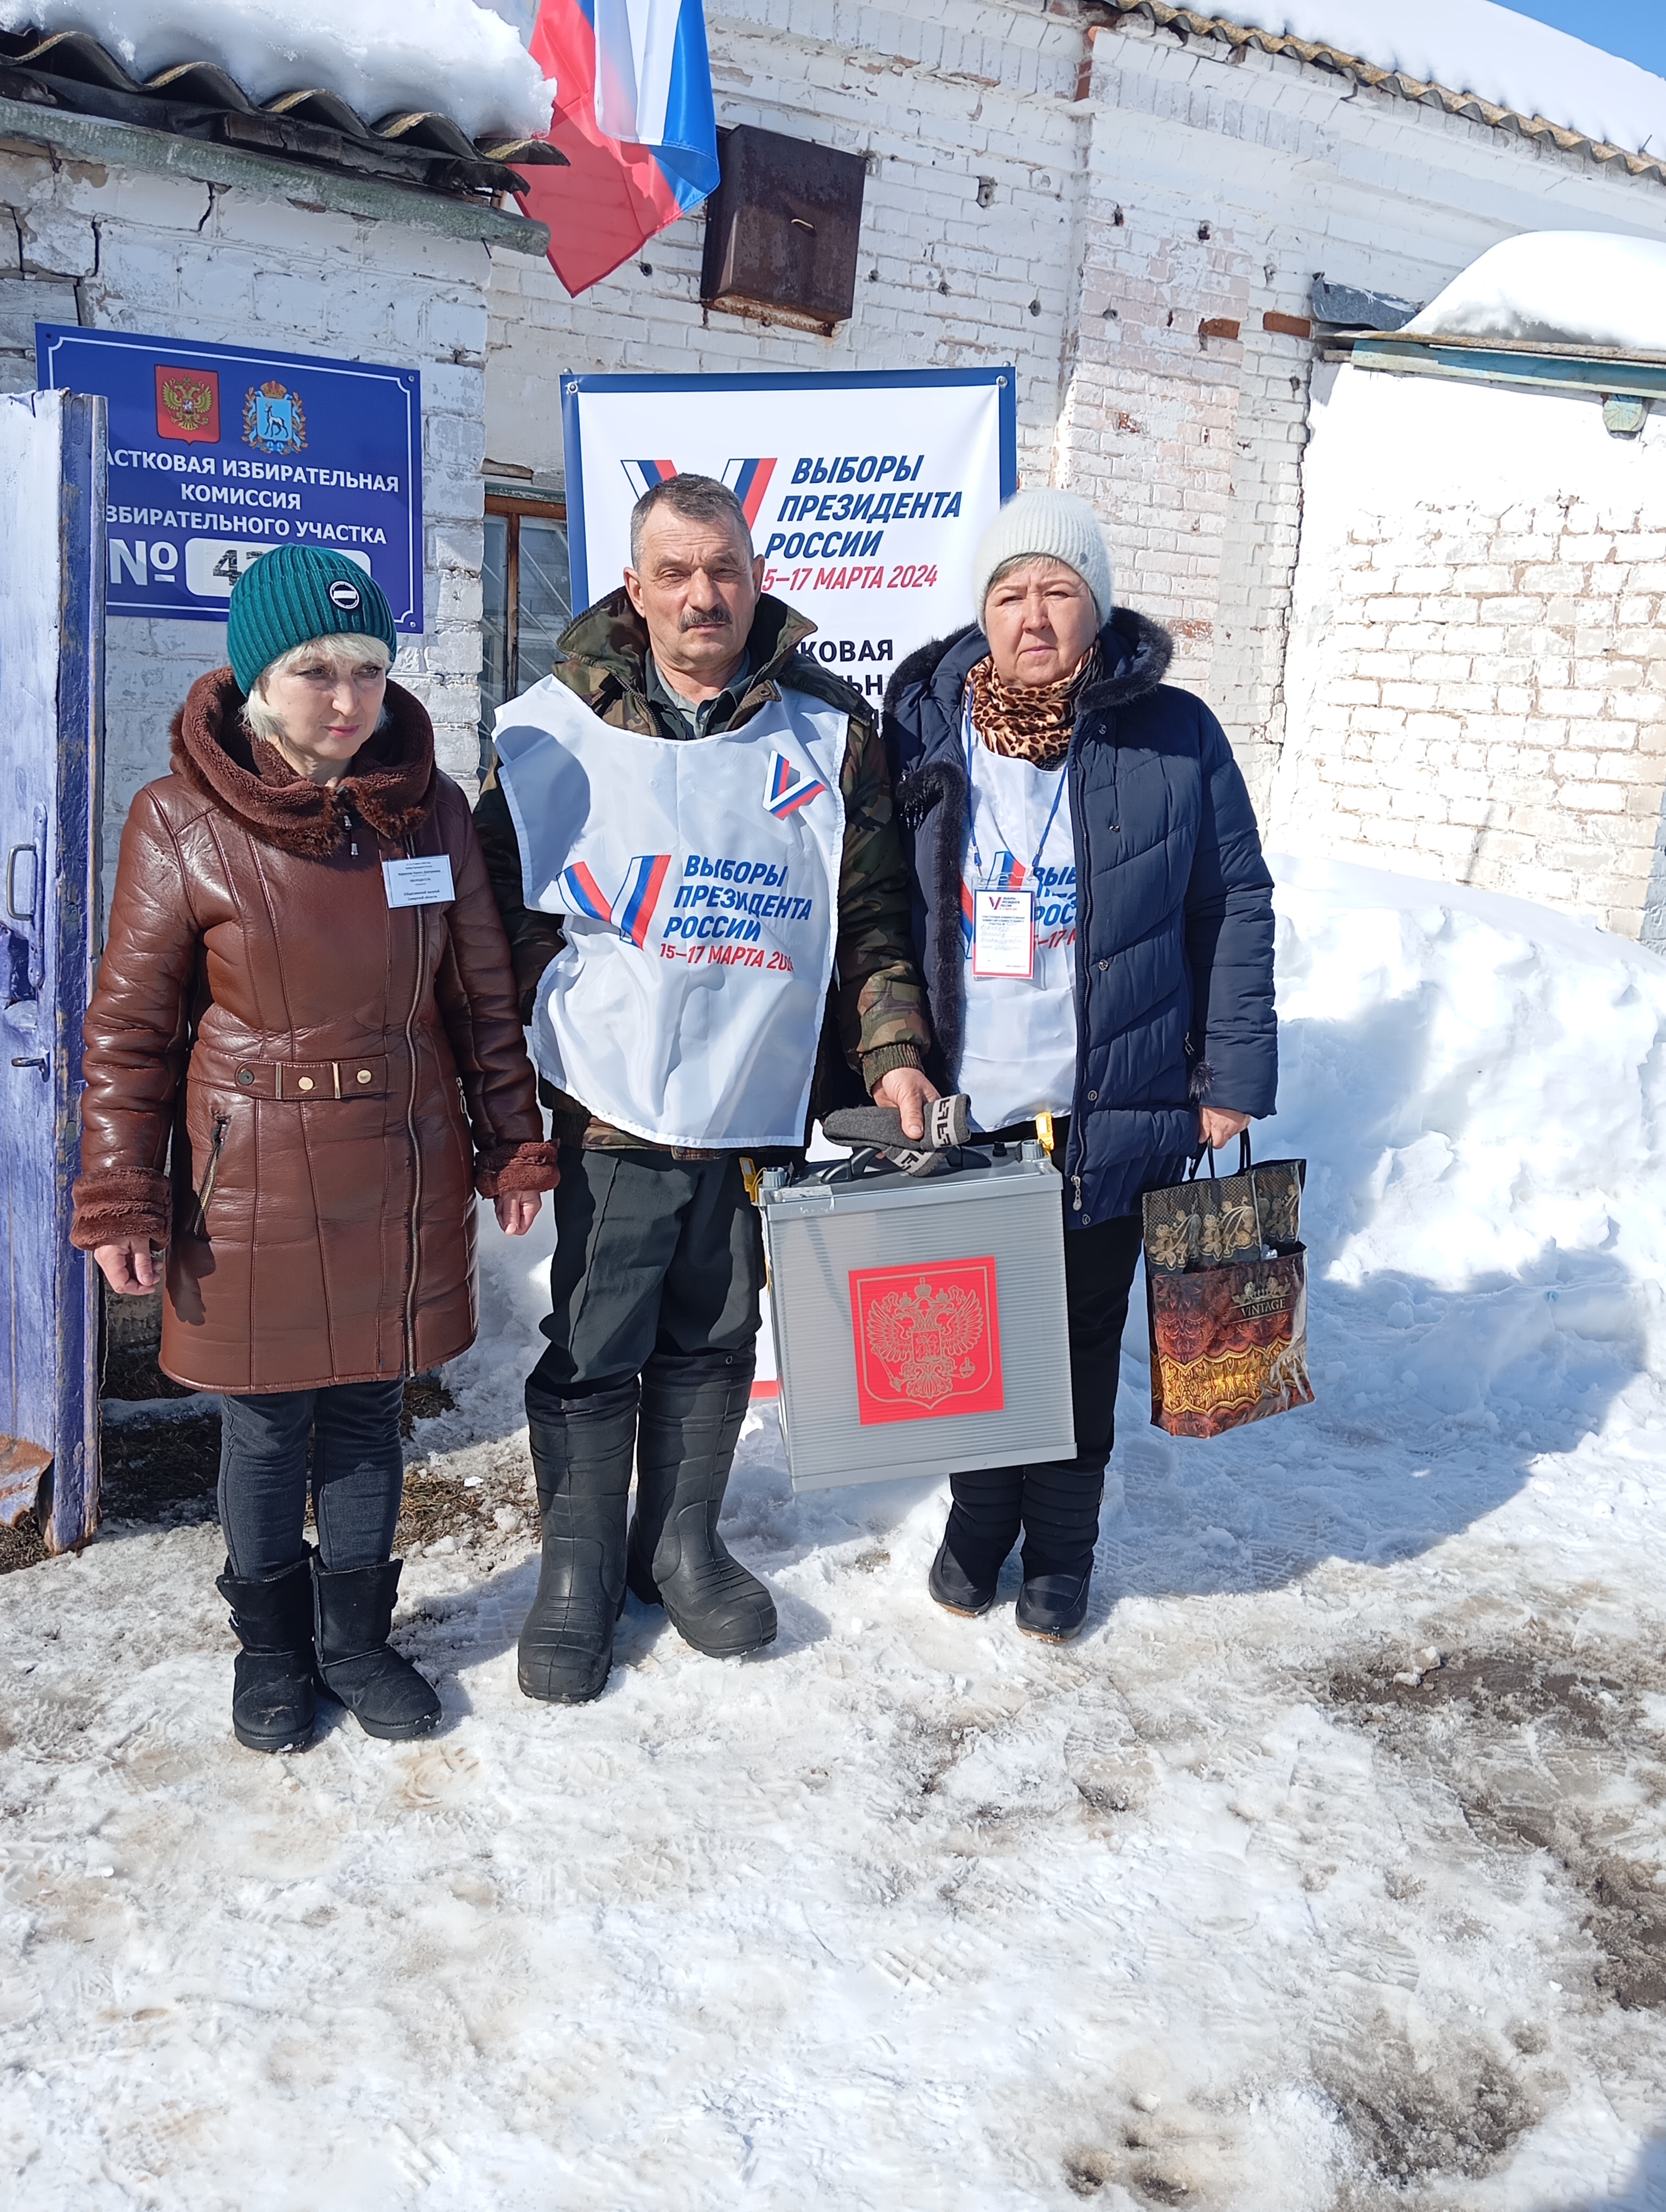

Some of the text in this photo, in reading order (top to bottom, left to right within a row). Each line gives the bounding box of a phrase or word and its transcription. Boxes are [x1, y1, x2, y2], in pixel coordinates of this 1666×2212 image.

[107, 448, 399, 492] АСТКОВАЯ ИЗБИРАТЕЛЬНАЯ
[791, 455, 925, 484] ВЫБОРЫ
[181, 483, 300, 510] КОМИССИЯ
[777, 491, 962, 524] ПРЕЗИДЕНТА
[106, 505, 387, 544] ЗБИРАТЕЛЬНОГО УЧАСТКА
[765, 530, 884, 559] РОССИИ
[762, 564, 938, 591] 5–17 МАРТА 2024
[797, 639, 893, 663] КОВАЯ
[684, 855, 789, 887] ВЫБОРЫ
[1033, 866, 1077, 886] ВЫБ
[674, 885, 812, 920] ПРЕЗИДЕНТА
[663, 916, 762, 942] РОССИИ
[708, 945, 765, 967] МАРТА
[1241, 1298, 1285, 1317] VINTAGE
